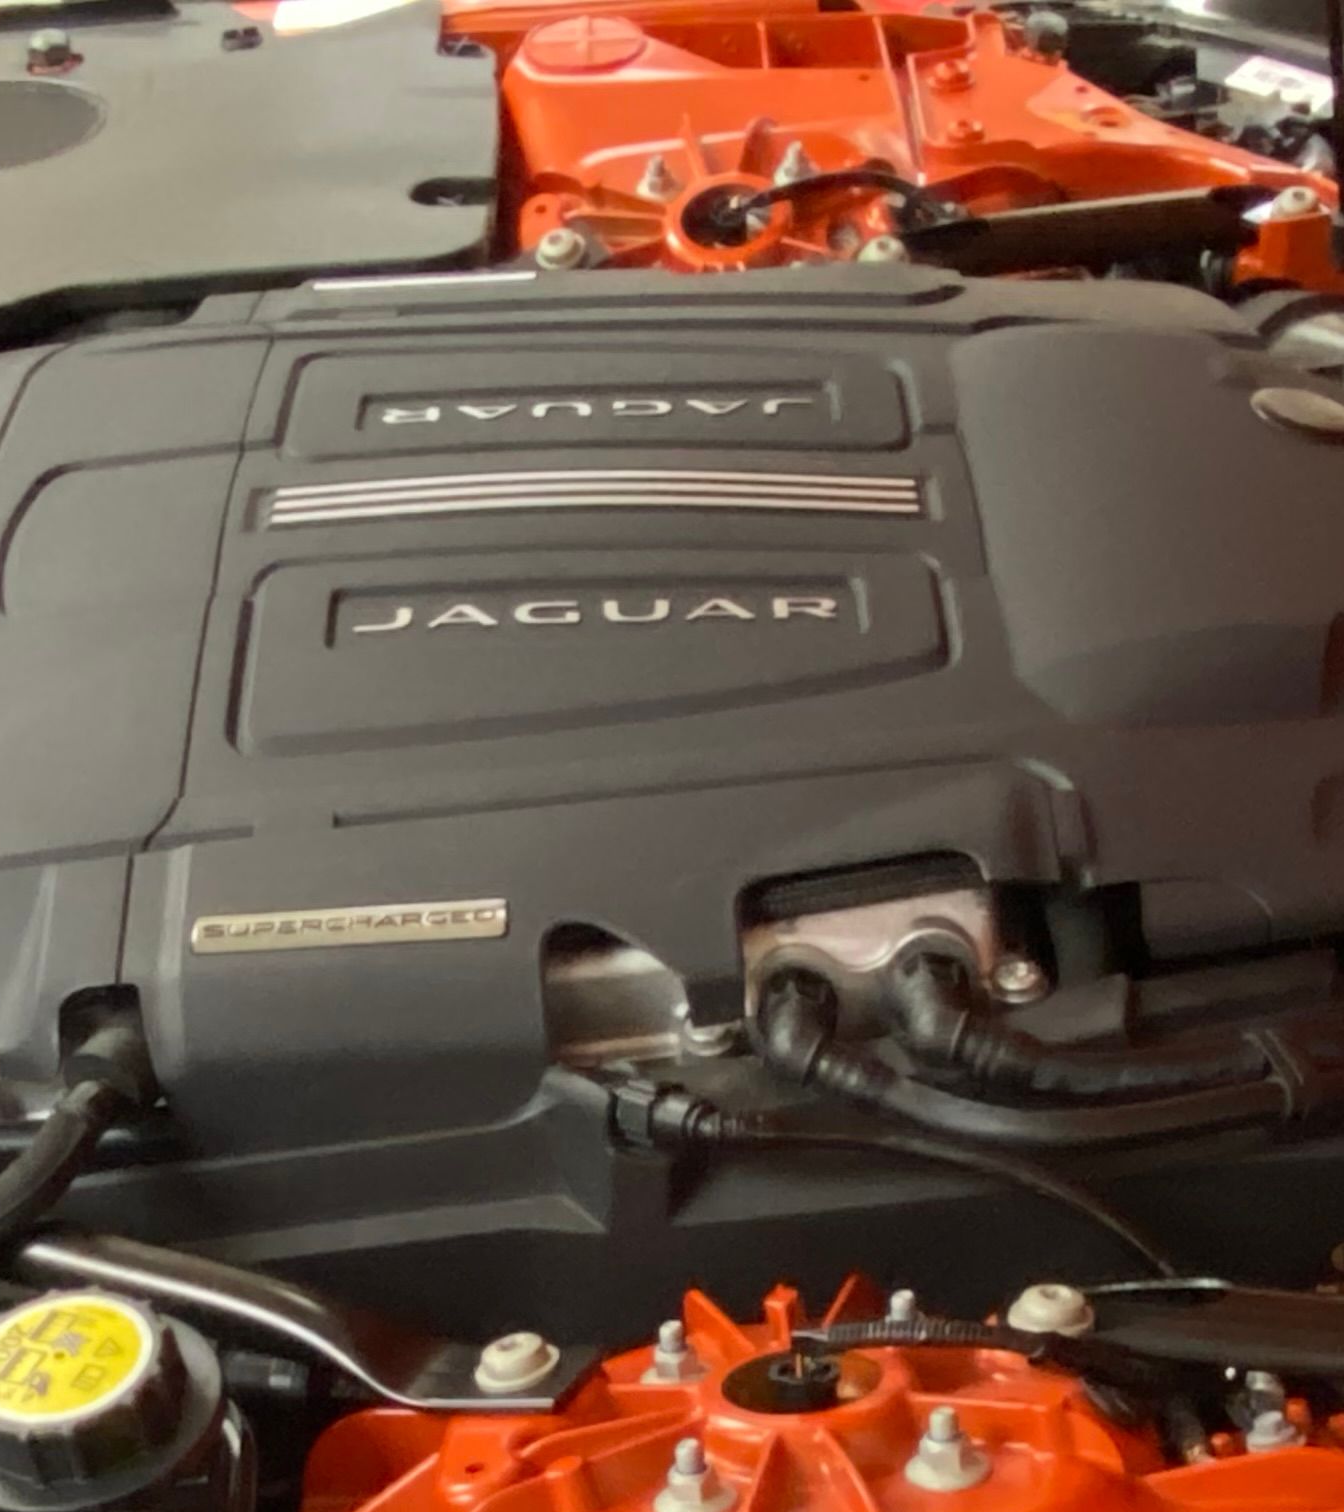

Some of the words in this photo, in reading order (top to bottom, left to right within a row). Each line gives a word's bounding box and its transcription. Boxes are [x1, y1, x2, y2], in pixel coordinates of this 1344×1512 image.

[381, 397, 814, 425] JAGUAR
[351, 596, 838, 634] JAGUAR
[202, 908, 498, 940] SUPERCHARGED
